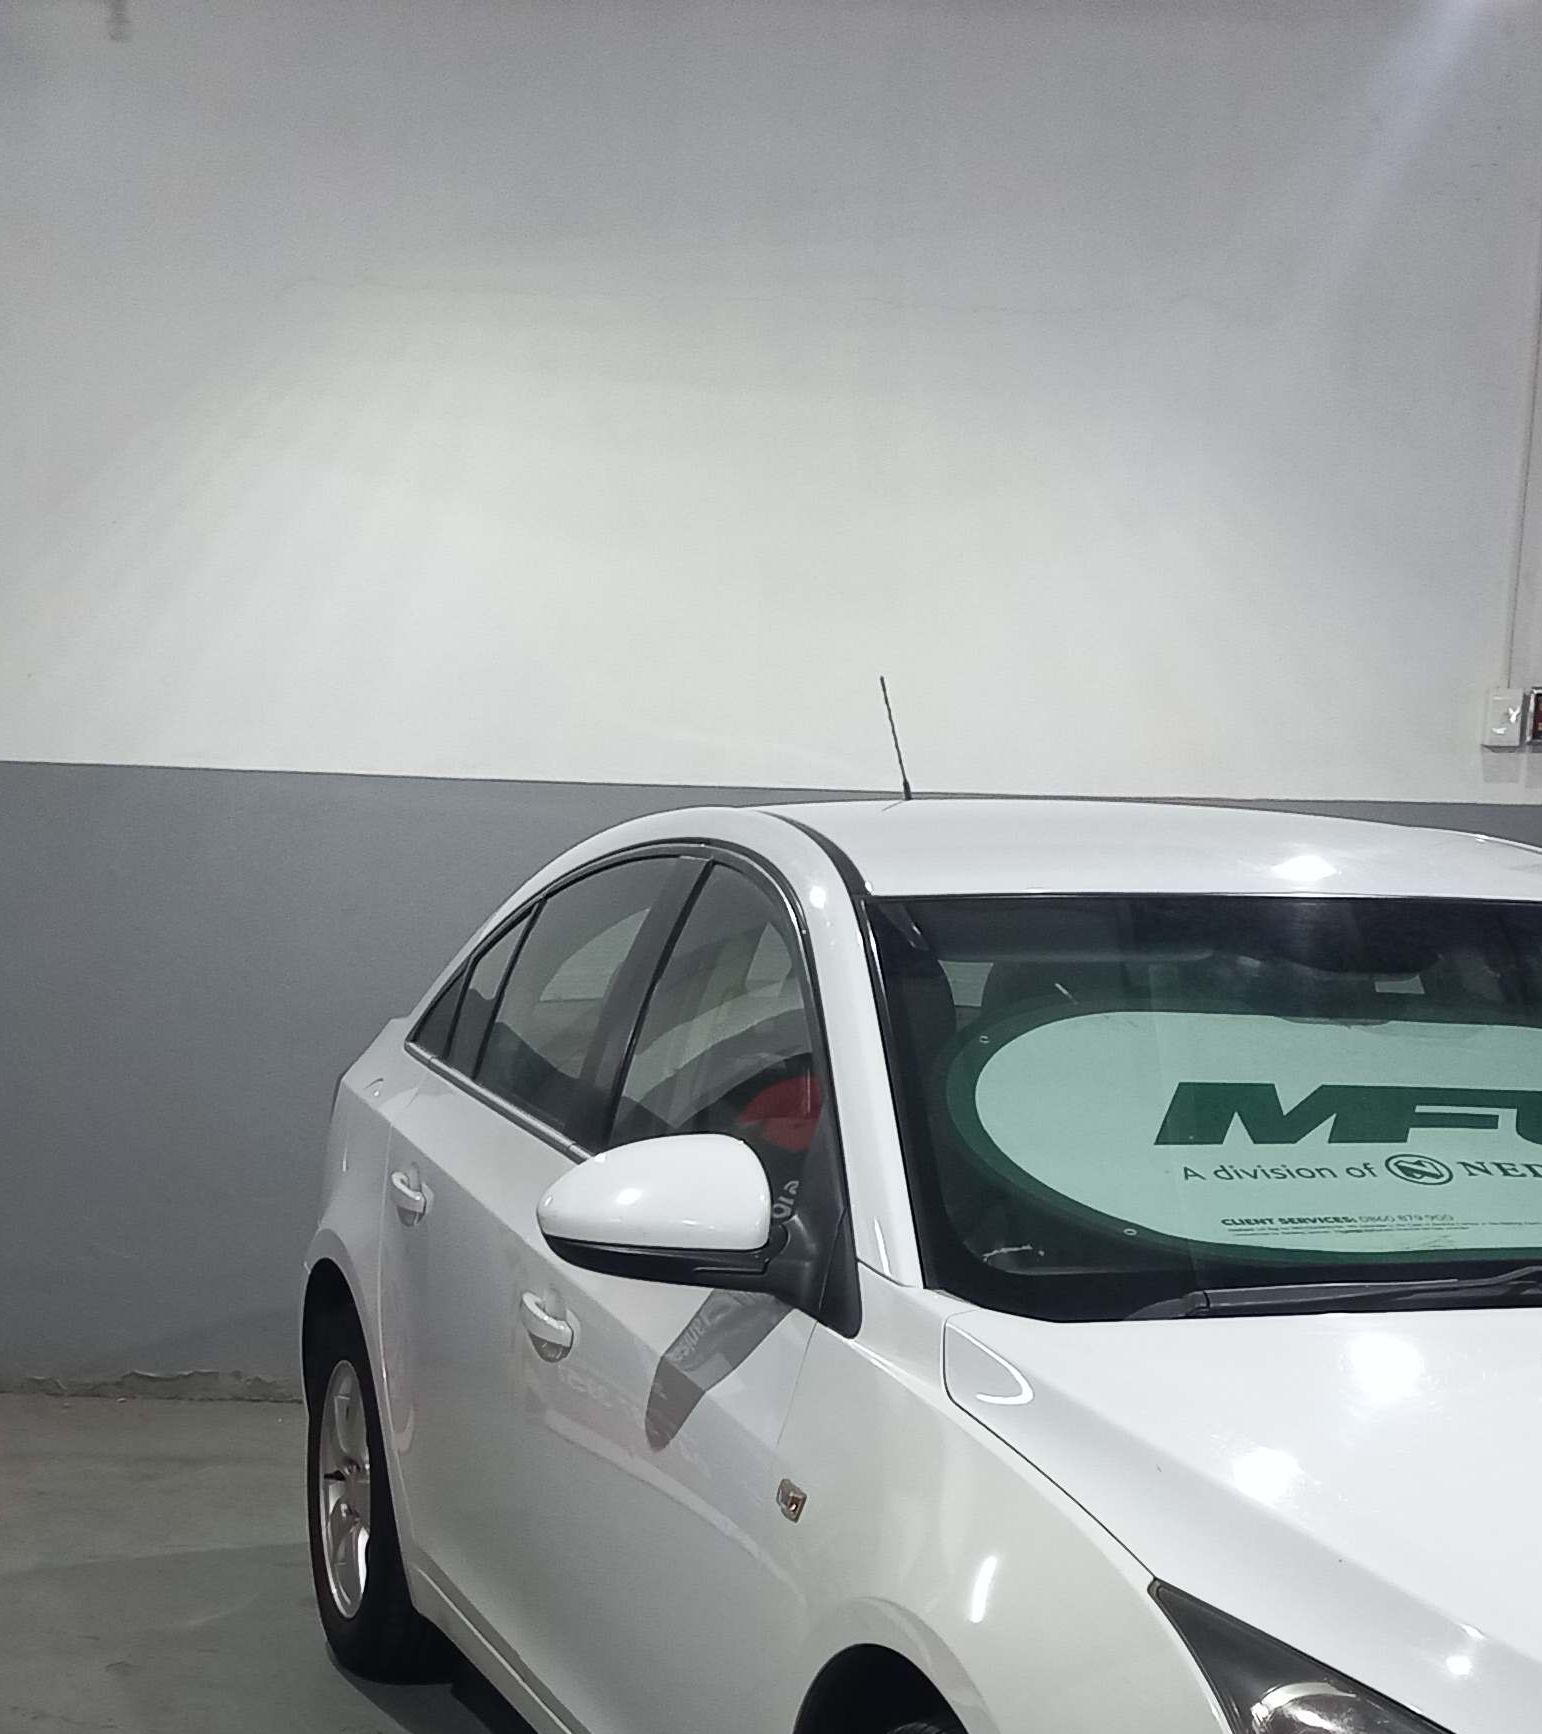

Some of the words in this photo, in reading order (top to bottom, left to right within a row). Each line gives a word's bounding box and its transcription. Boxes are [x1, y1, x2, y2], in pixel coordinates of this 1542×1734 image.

[1183, 1166, 1206, 1181] A
[1212, 1164, 1337, 1181] division
[1345, 1162, 1378, 1180] of
[1220, 1216, 1274, 1227] CLIENT
